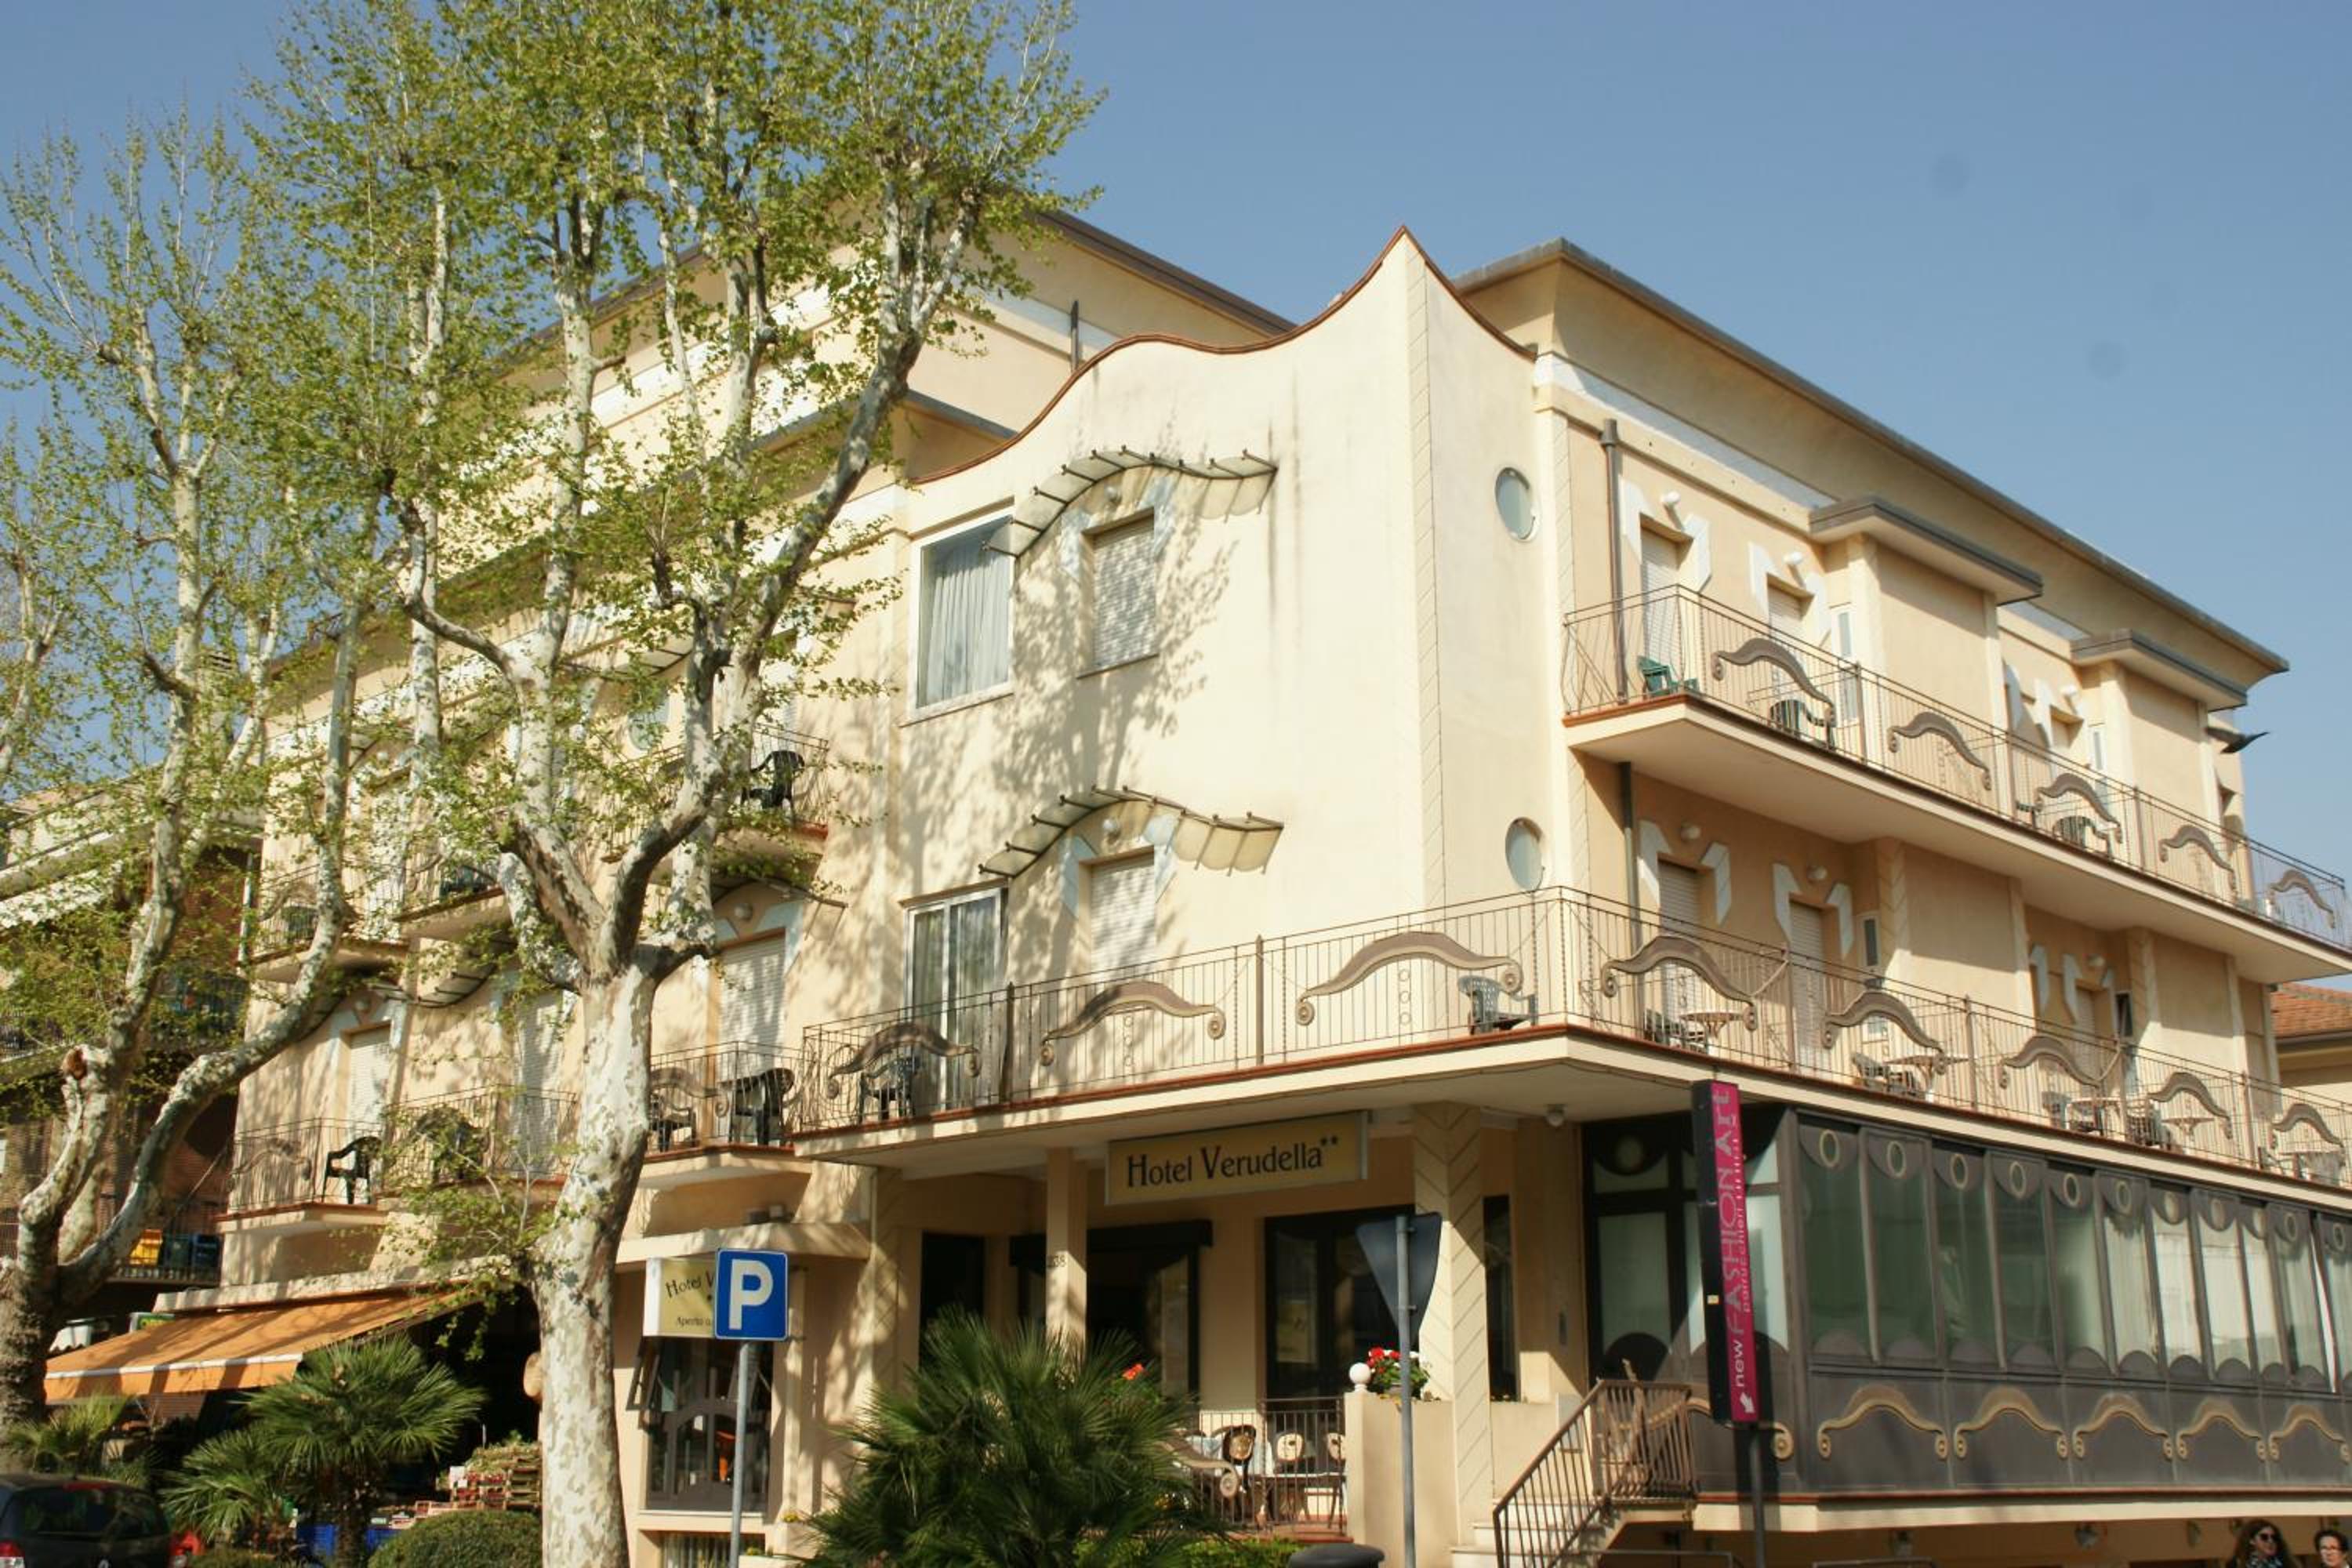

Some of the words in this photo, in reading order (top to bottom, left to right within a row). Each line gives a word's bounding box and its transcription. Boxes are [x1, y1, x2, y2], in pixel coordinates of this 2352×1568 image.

[1127, 1153, 1192, 1188] Hotel
[1200, 1142, 1323, 1180] Verudella
[1717, 1167, 1744, 1334] FASHION
[665, 1276, 702, 1299] Hotel
[728, 1258, 774, 1330] P
[1733, 1339, 1744, 1387] new
